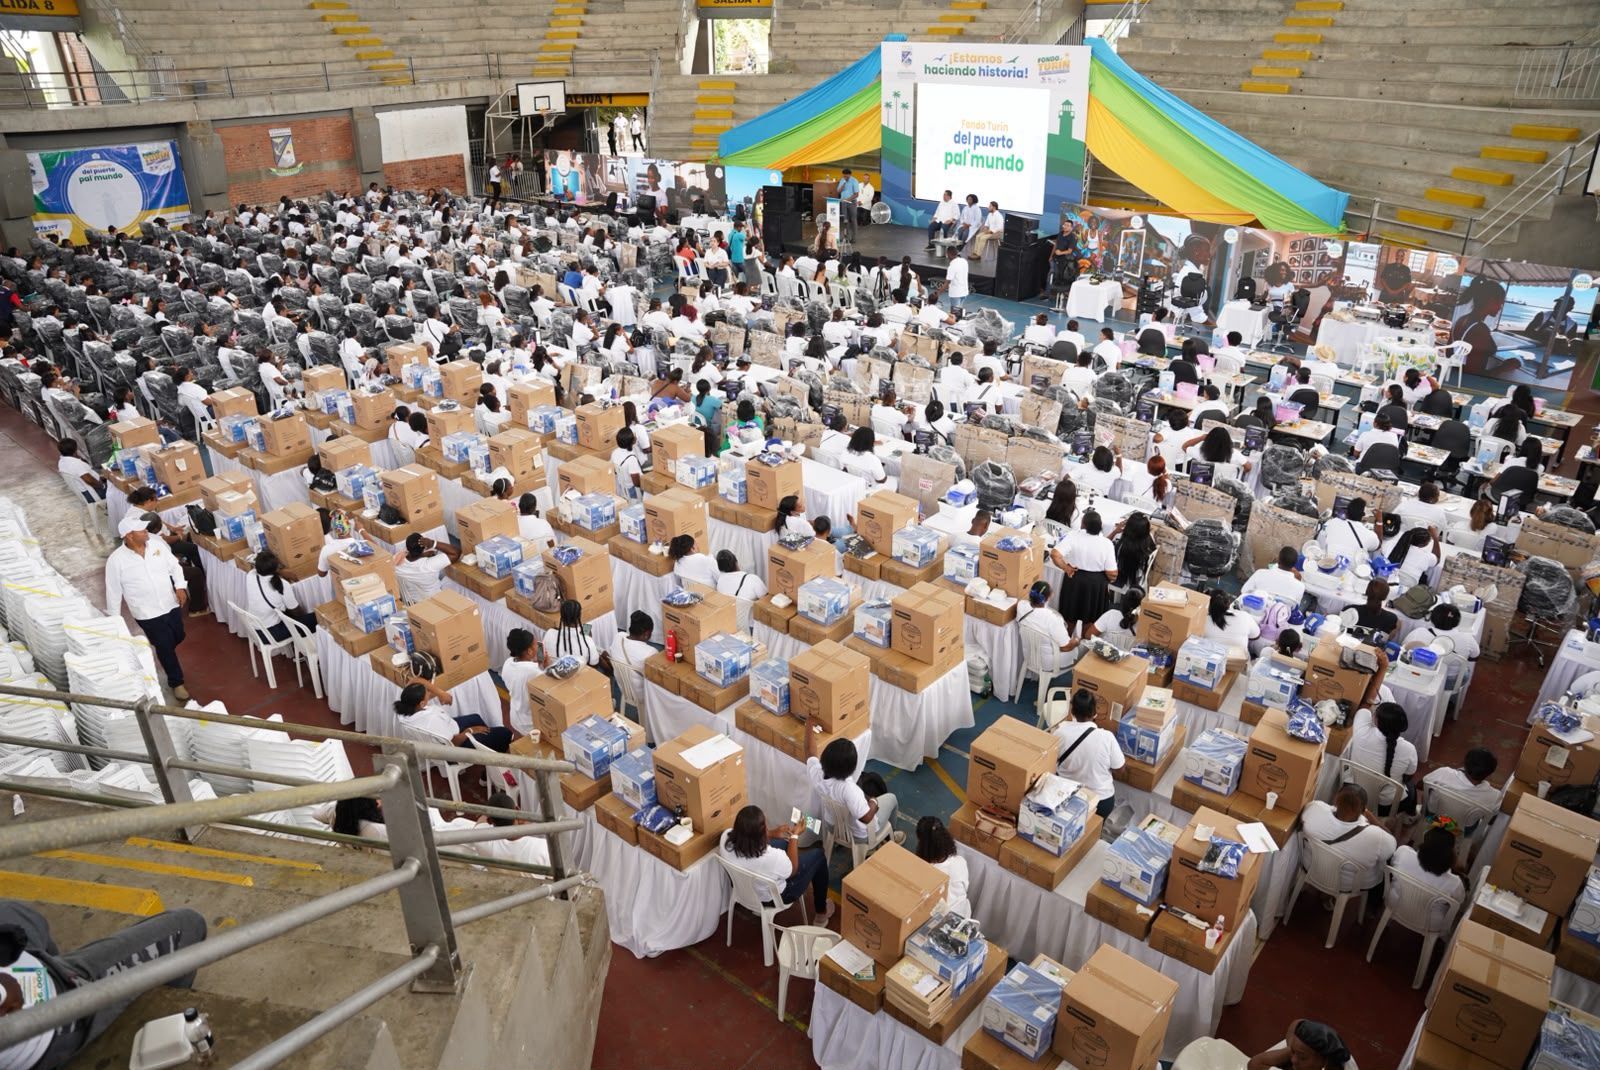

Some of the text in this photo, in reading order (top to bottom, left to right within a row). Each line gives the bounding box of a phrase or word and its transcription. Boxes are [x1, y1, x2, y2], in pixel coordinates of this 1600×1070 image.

[44, 0, 54, 10] 8
[949, 53, 1003, 64] ¡Estamos
[924, 64, 976, 76] haciendo
[978, 65, 1028, 78] historia!
[961, 120, 985, 130] Fondo
[954, 130, 1013, 150] del puerto
[94, 172, 123, 181] mundo
